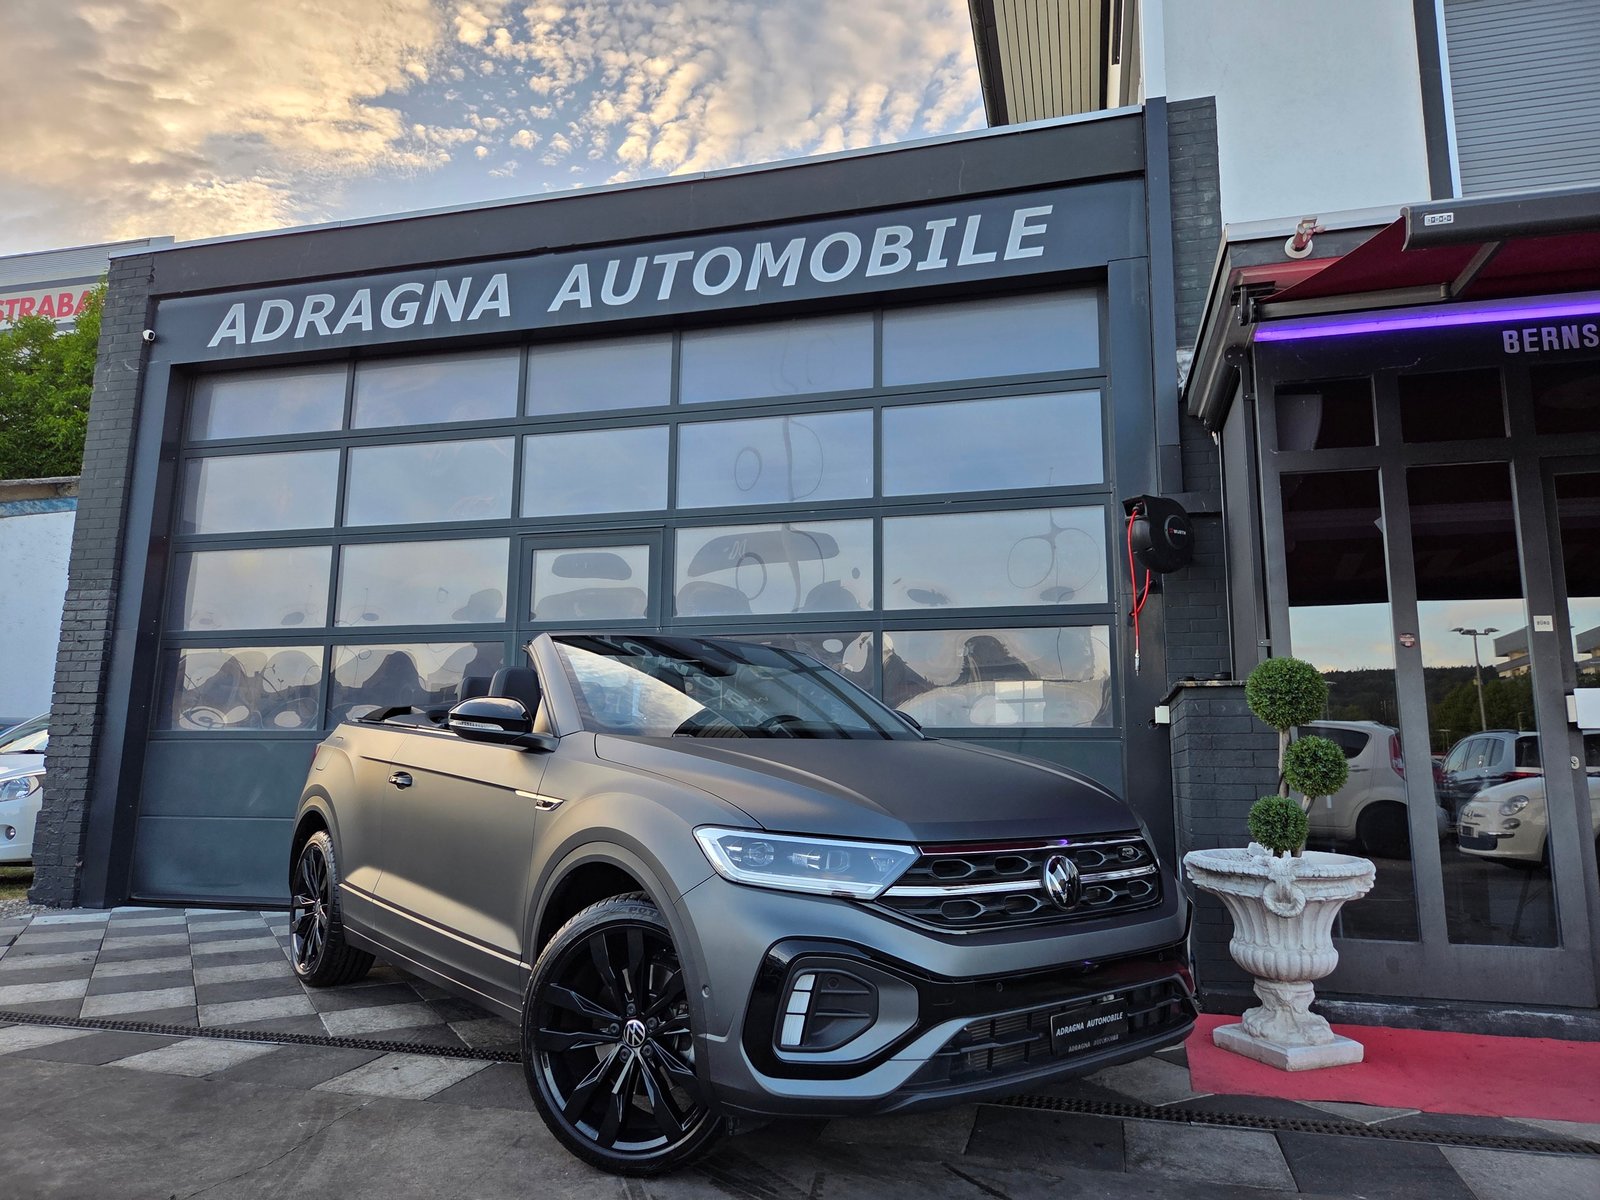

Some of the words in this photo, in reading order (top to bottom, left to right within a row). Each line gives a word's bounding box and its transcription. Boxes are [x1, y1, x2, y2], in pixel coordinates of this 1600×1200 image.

[206, 273, 511, 348] ADRAGNA
[547, 205, 1054, 313] AUTOMOBILE
[1502, 323, 1600, 354] BERNS
[1055, 1022, 1085, 1037] ADRAGNA
[1086, 1011, 1124, 1029] AUTOMOBILE
